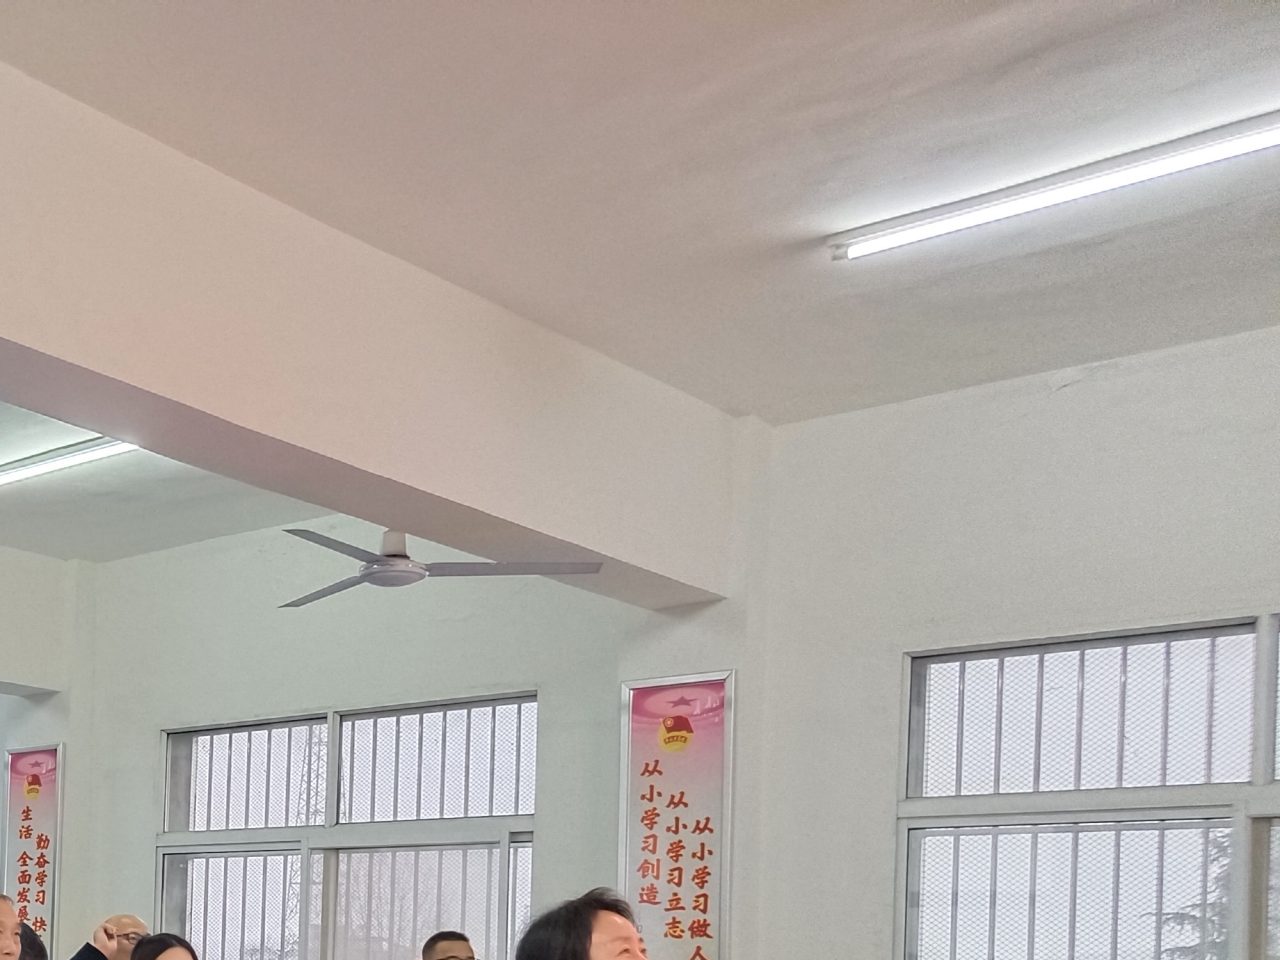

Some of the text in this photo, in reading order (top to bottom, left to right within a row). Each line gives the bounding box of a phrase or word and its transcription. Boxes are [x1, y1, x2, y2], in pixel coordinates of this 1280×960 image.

[636, 759, 664, 906] 从小学习创造
[664, 791, 689, 940] 从小学习立志
